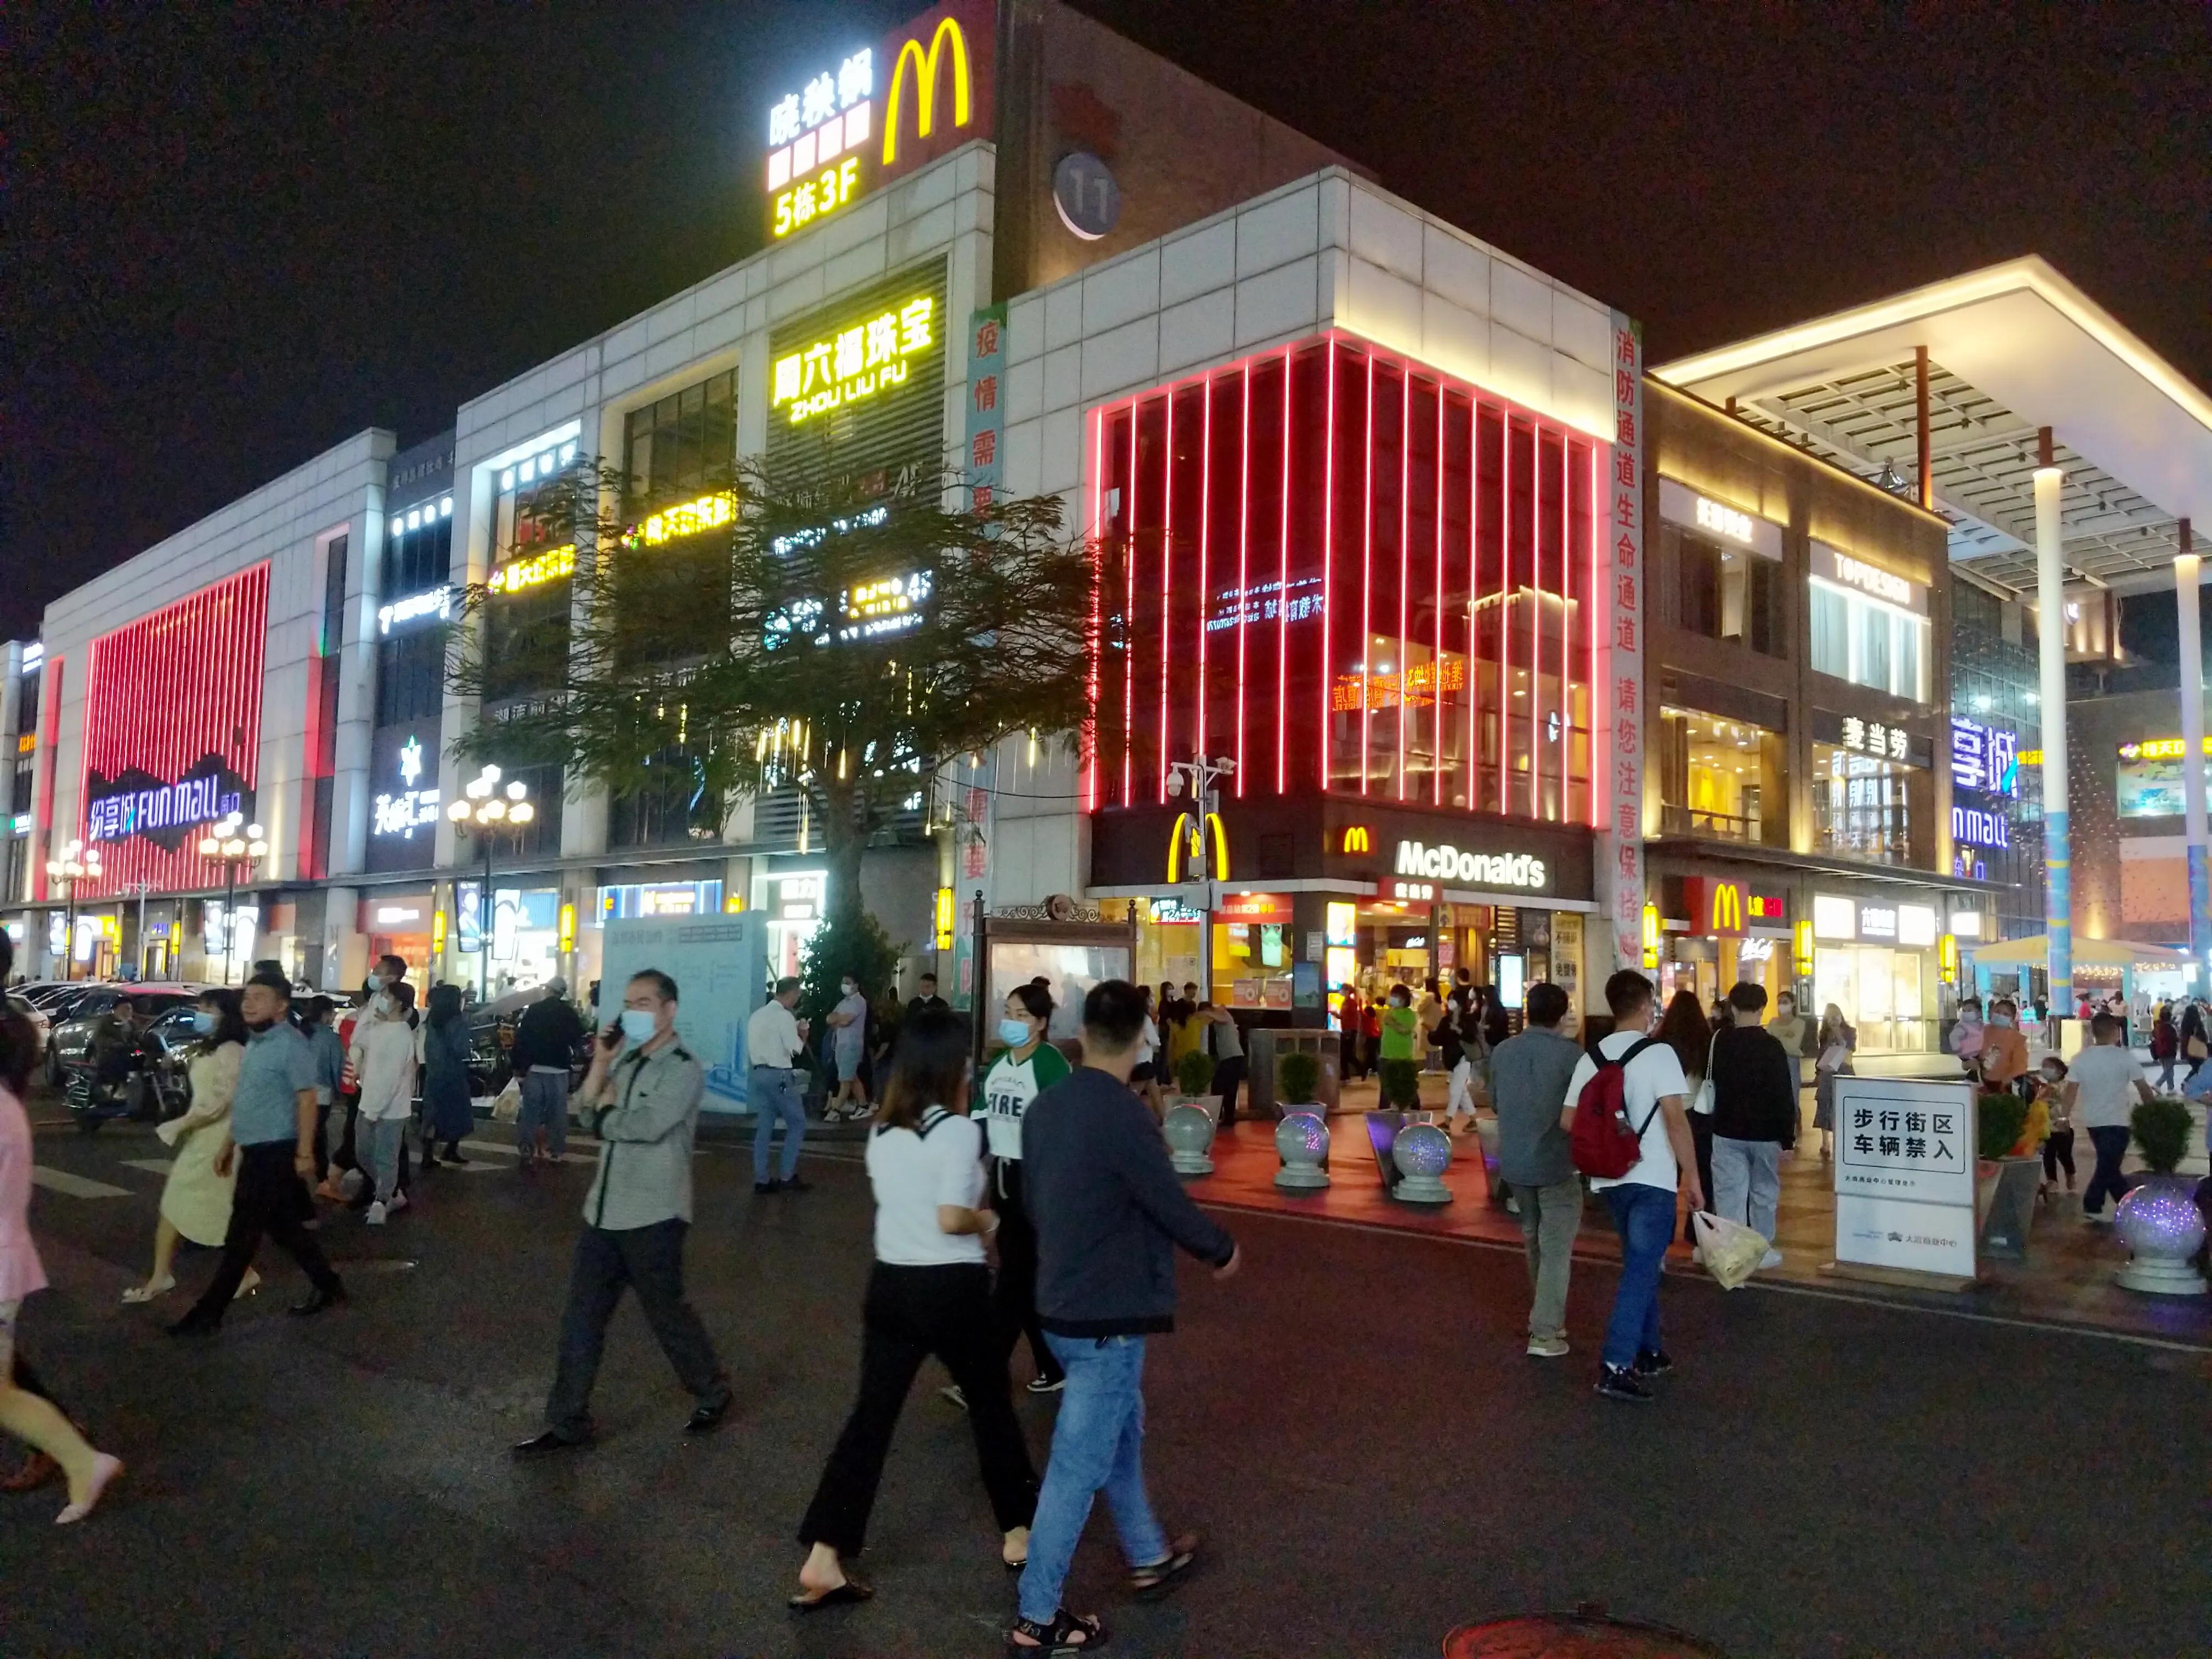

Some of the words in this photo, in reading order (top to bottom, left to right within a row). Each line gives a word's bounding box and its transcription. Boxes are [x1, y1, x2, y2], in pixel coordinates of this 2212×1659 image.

[774, 297, 932, 407] 周六福珠宝
[791, 387, 840, 422] ZHOU
[845, 373, 874, 400] LIU
[880, 360, 906, 388] FU
[1615, 326, 1637, 653] 消防通道生命通道
[1843, 717, 1907, 759] 麦当劳
[1951, 718, 2018, 798] 享城
[1397, 840, 1545, 887] McDonald's
[989, 1093, 1023, 1117] FIRE
[1854, 1108, 1954, 1135] 步行街区
[1854, 1134, 1954, 1160] 车辆禁入
